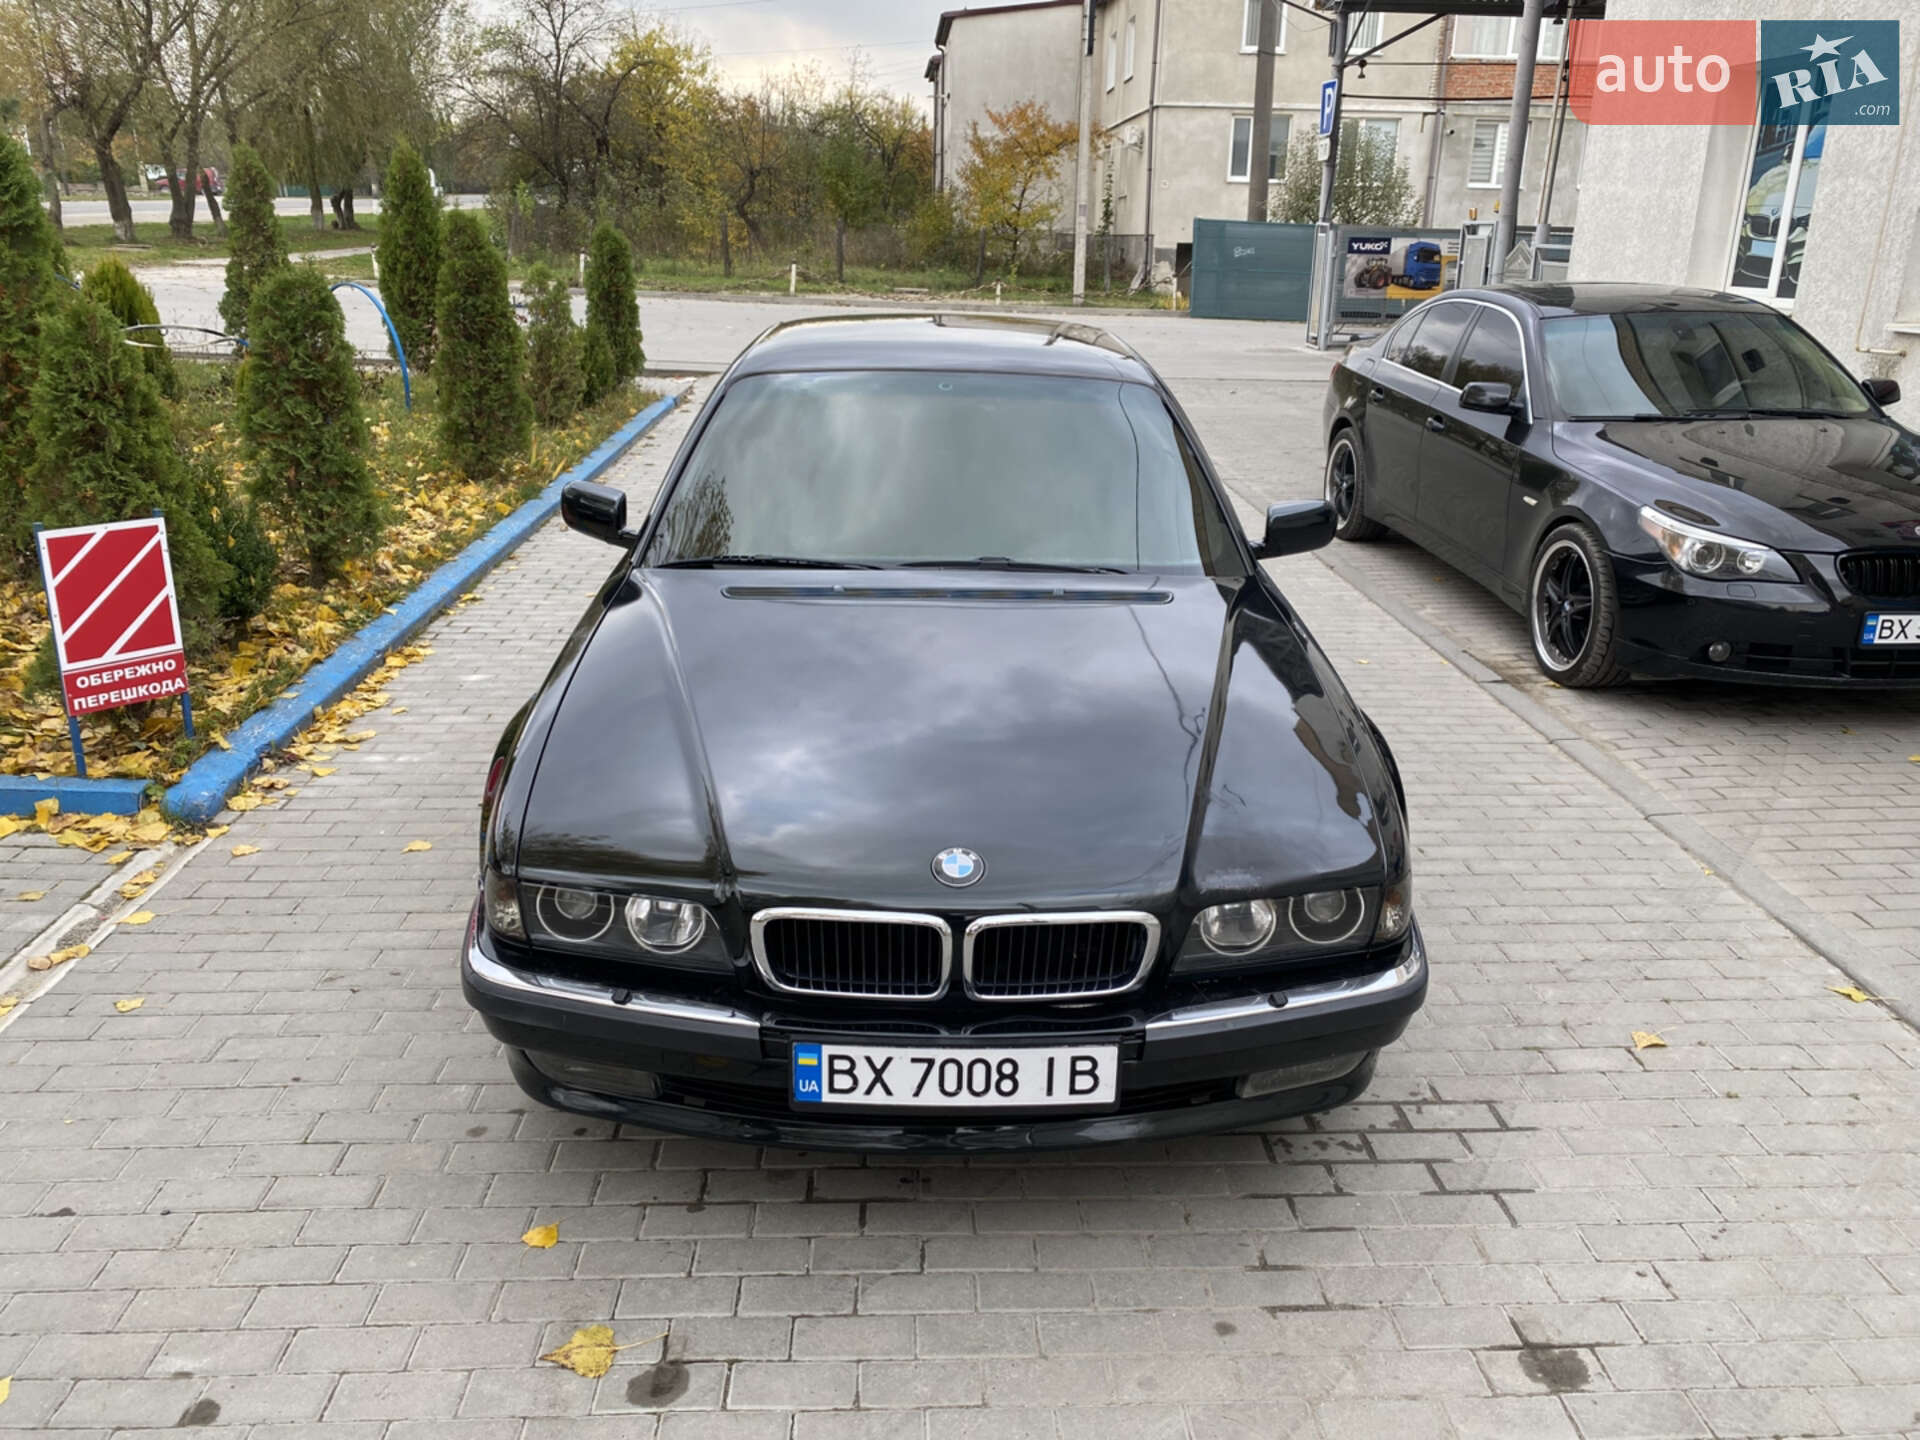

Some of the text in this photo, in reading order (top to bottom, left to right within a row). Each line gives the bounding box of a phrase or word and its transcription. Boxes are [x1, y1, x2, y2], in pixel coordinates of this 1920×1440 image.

[1323, 87, 1334, 129] P
[1878, 619, 1912, 640] BX
[76, 659, 176, 689] ОБЕРЕЖНО
[73, 677, 185, 711] ПЕРЕШКОДА
[799, 1054, 1100, 1098] UA BX 7008 IB
